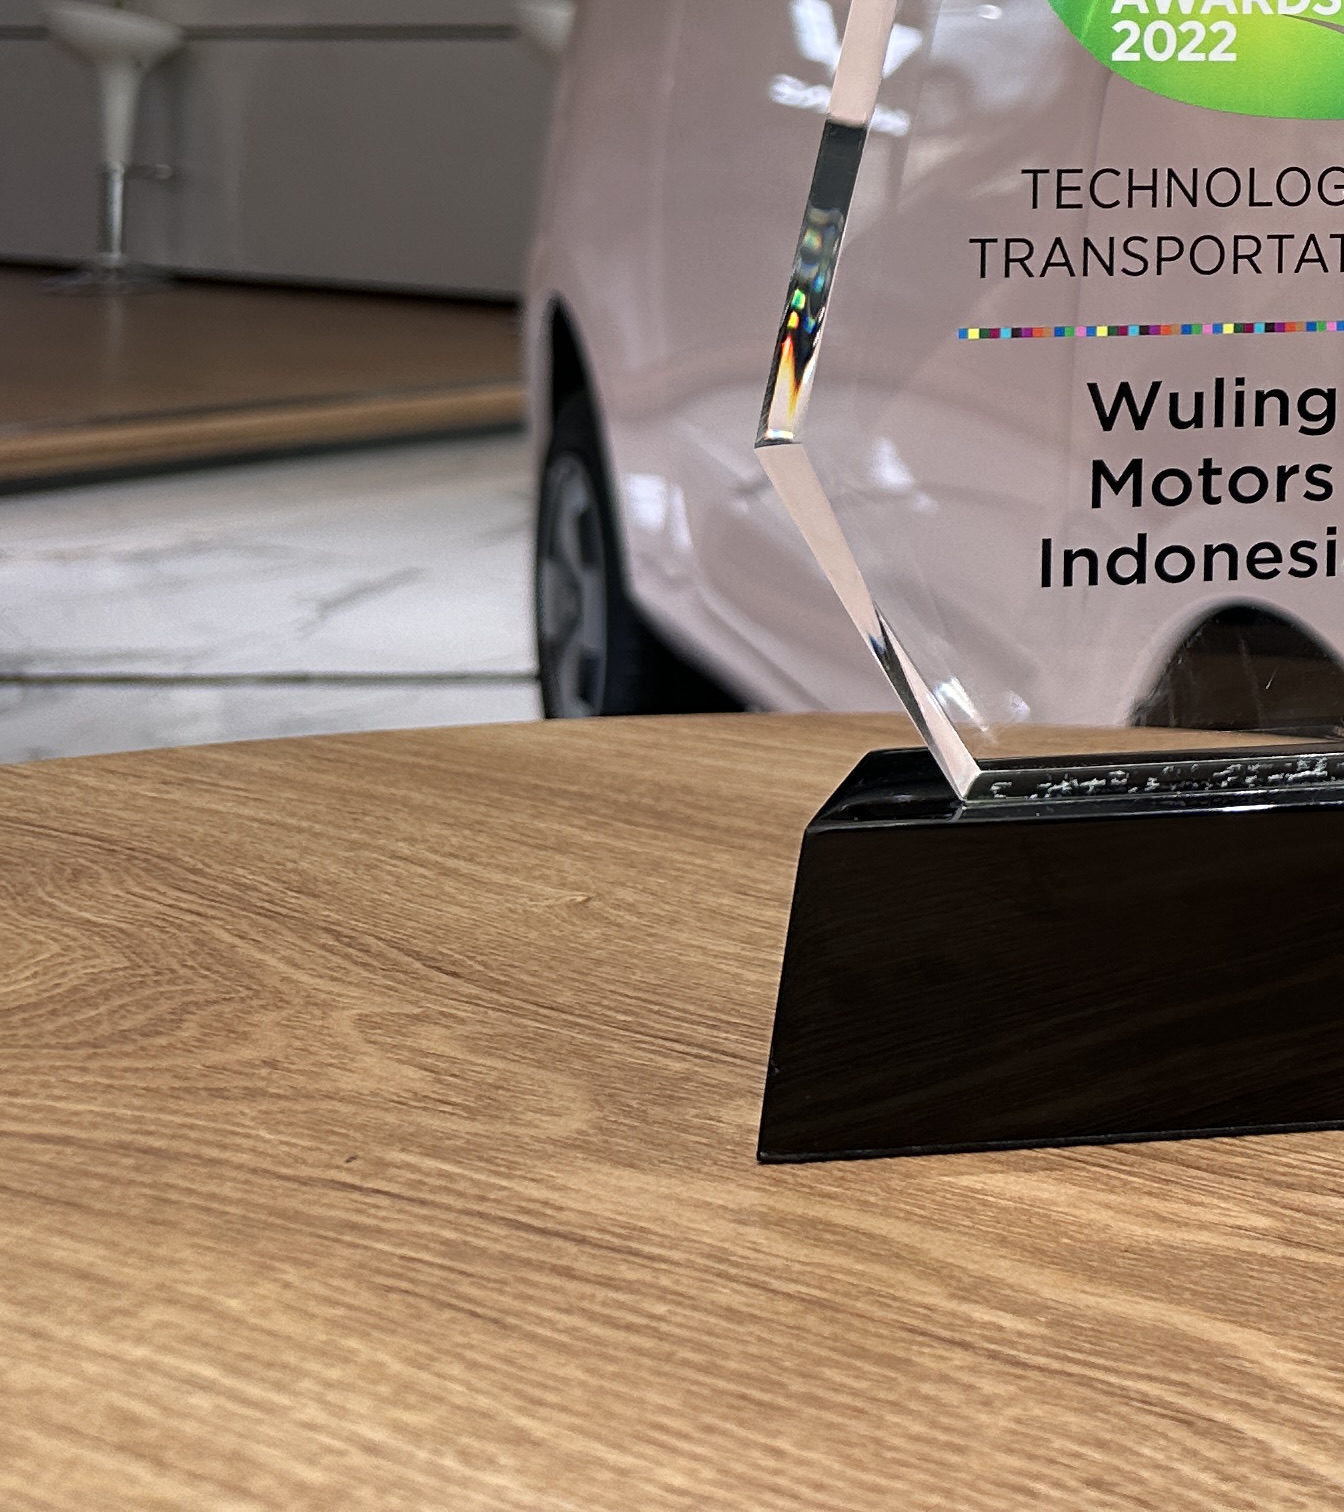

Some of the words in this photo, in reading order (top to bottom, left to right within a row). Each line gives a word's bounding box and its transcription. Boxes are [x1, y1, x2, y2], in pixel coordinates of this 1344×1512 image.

[1111, 19, 1238, 63] 2022
[1086, 376, 1338, 437] Wuling
[1091, 457, 1334, 509] Motors
